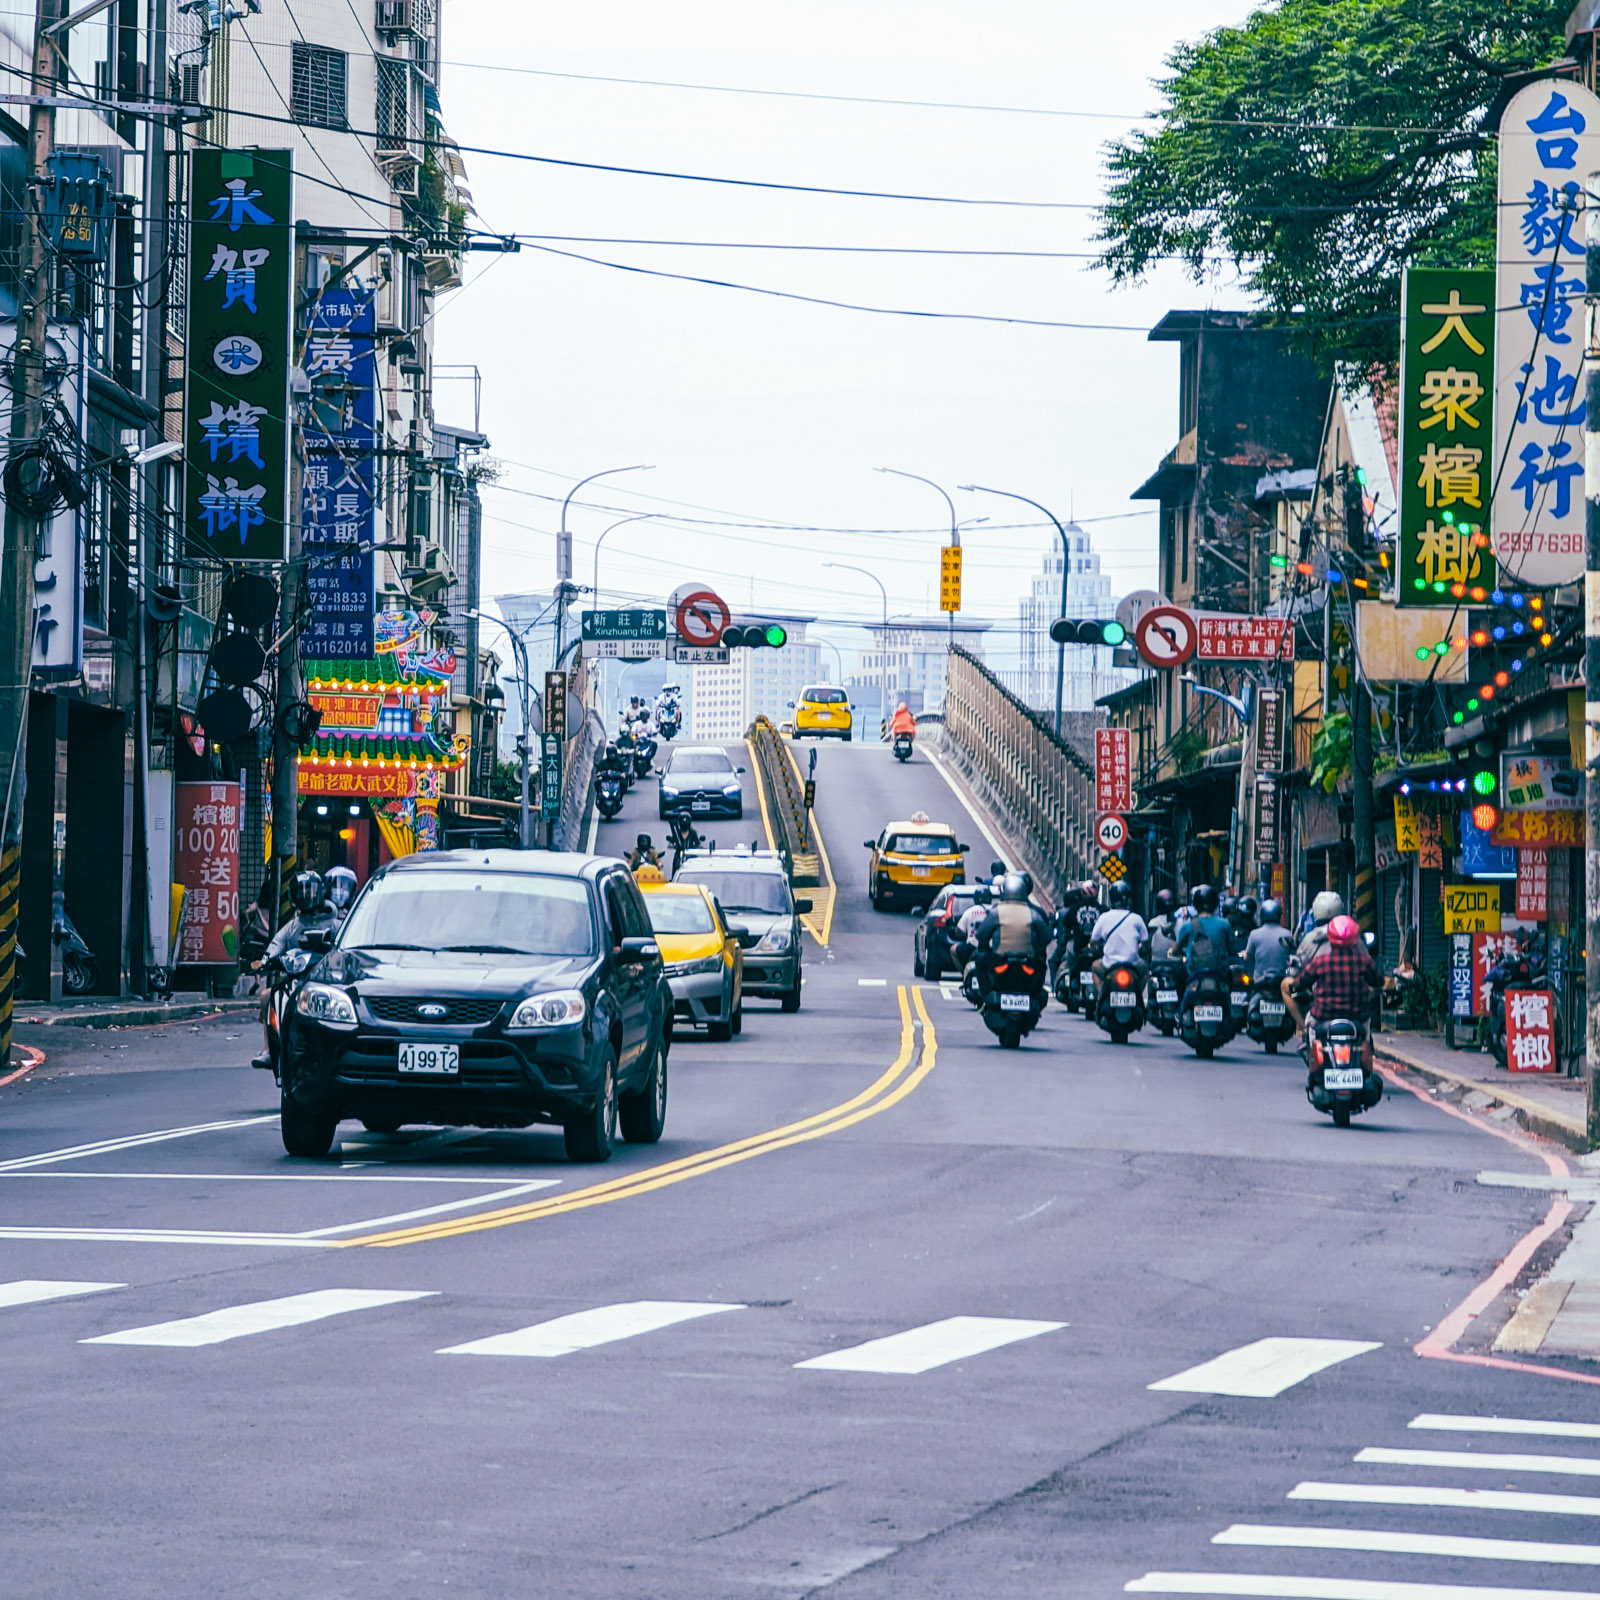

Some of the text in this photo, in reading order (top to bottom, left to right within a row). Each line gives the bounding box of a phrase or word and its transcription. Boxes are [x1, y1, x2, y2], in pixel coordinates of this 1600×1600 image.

[593, 612, 655, 627] 新莊路
[1201, 619, 1292, 637] 新海橋禁止行人
[594, 627, 638, 637] Xinzhuang
[678, 649, 728, 661] 禁止左轉
[1201, 639, 1292, 655] 及自行車通行
[547, 757, 558, 799] 大觀街
[1101, 732, 1112, 809] 及自行車通行
[1114, 731, 1126, 810] 新海橋禁止行人
[192, 804, 236, 826] 檳榔
[177, 827, 215, 853] 100
[1101, 825, 1121, 839] 40
[200, 857, 231, 886] 送
[1511, 993, 1552, 1069] 檳榔
